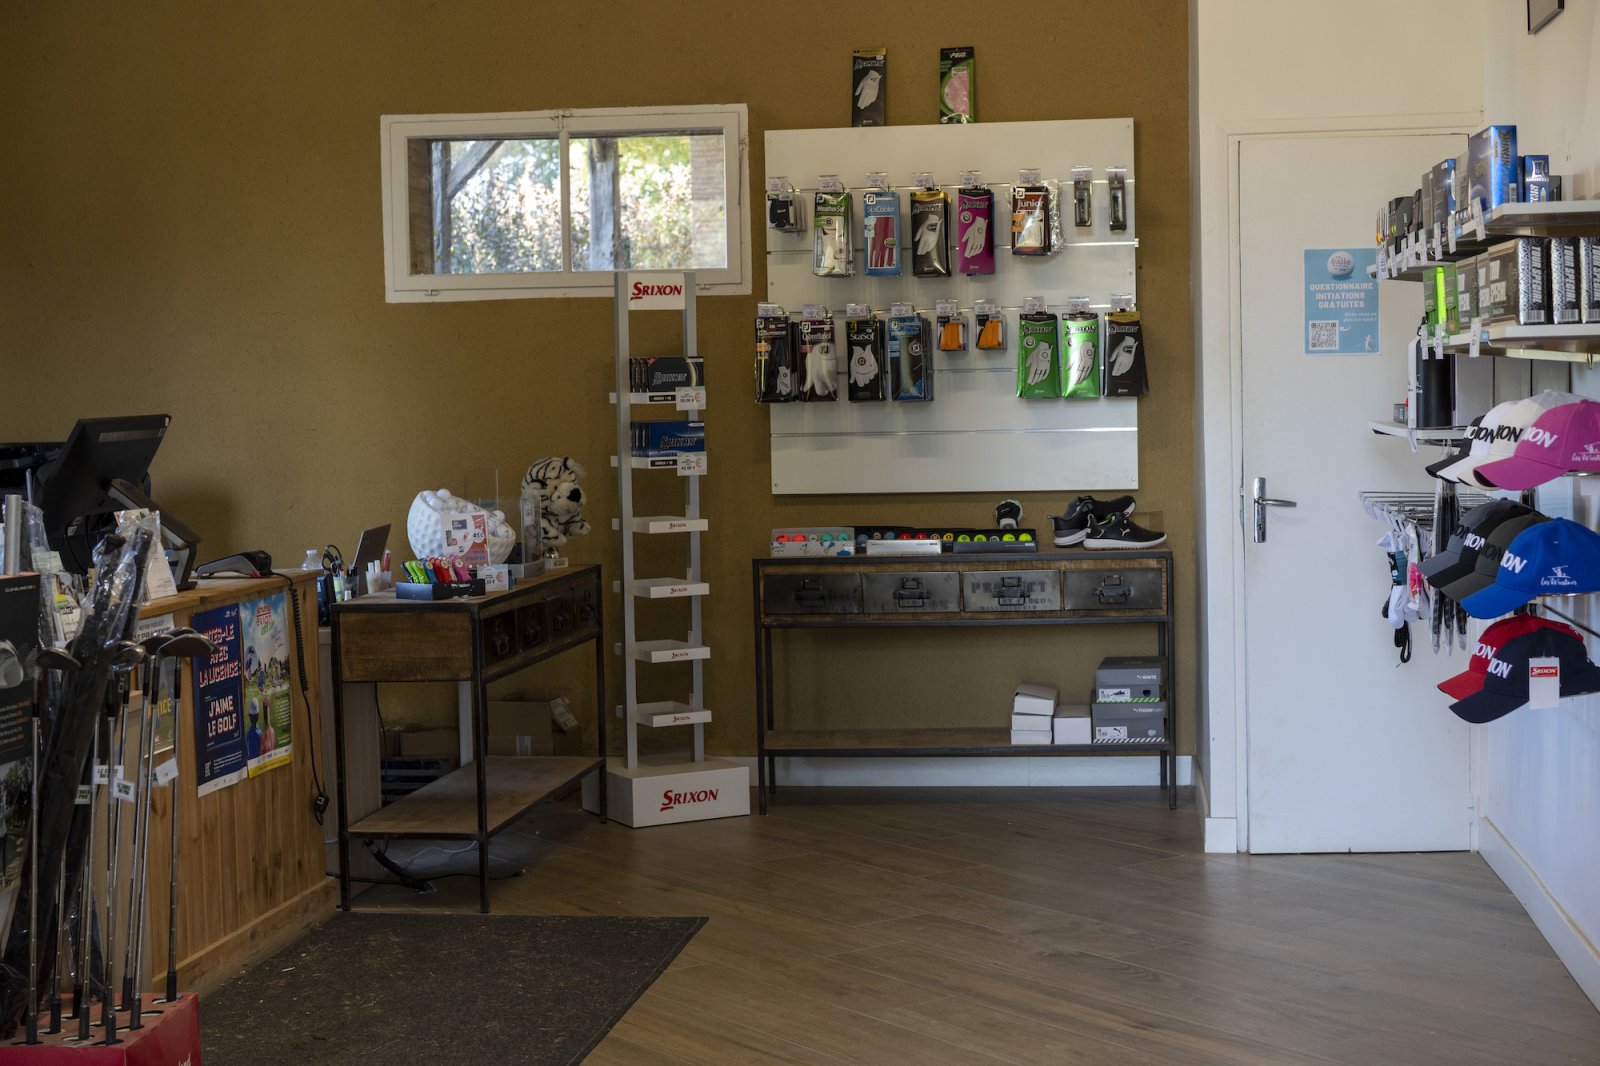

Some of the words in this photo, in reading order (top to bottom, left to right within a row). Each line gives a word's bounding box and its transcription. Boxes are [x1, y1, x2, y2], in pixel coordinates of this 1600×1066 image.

[1017, 200, 1043, 208] Junior
[630, 281, 683, 301] SRIXON
[1309, 283, 1374, 291] QUESTIONNAIRE
[1315, 292, 1365, 300] INITIATIONS
[1318, 301, 1365, 309] GRATUITES
[849, 333, 875, 341] StaSof
[1532, 667, 1557, 676] SRIXON
[198, 669, 209, 688] LA
[209, 695, 234, 718] J'AIME
[208, 720, 217, 738] LE
[217, 713, 237, 733] GOLF
[659, 789, 719, 812] SRIXON
